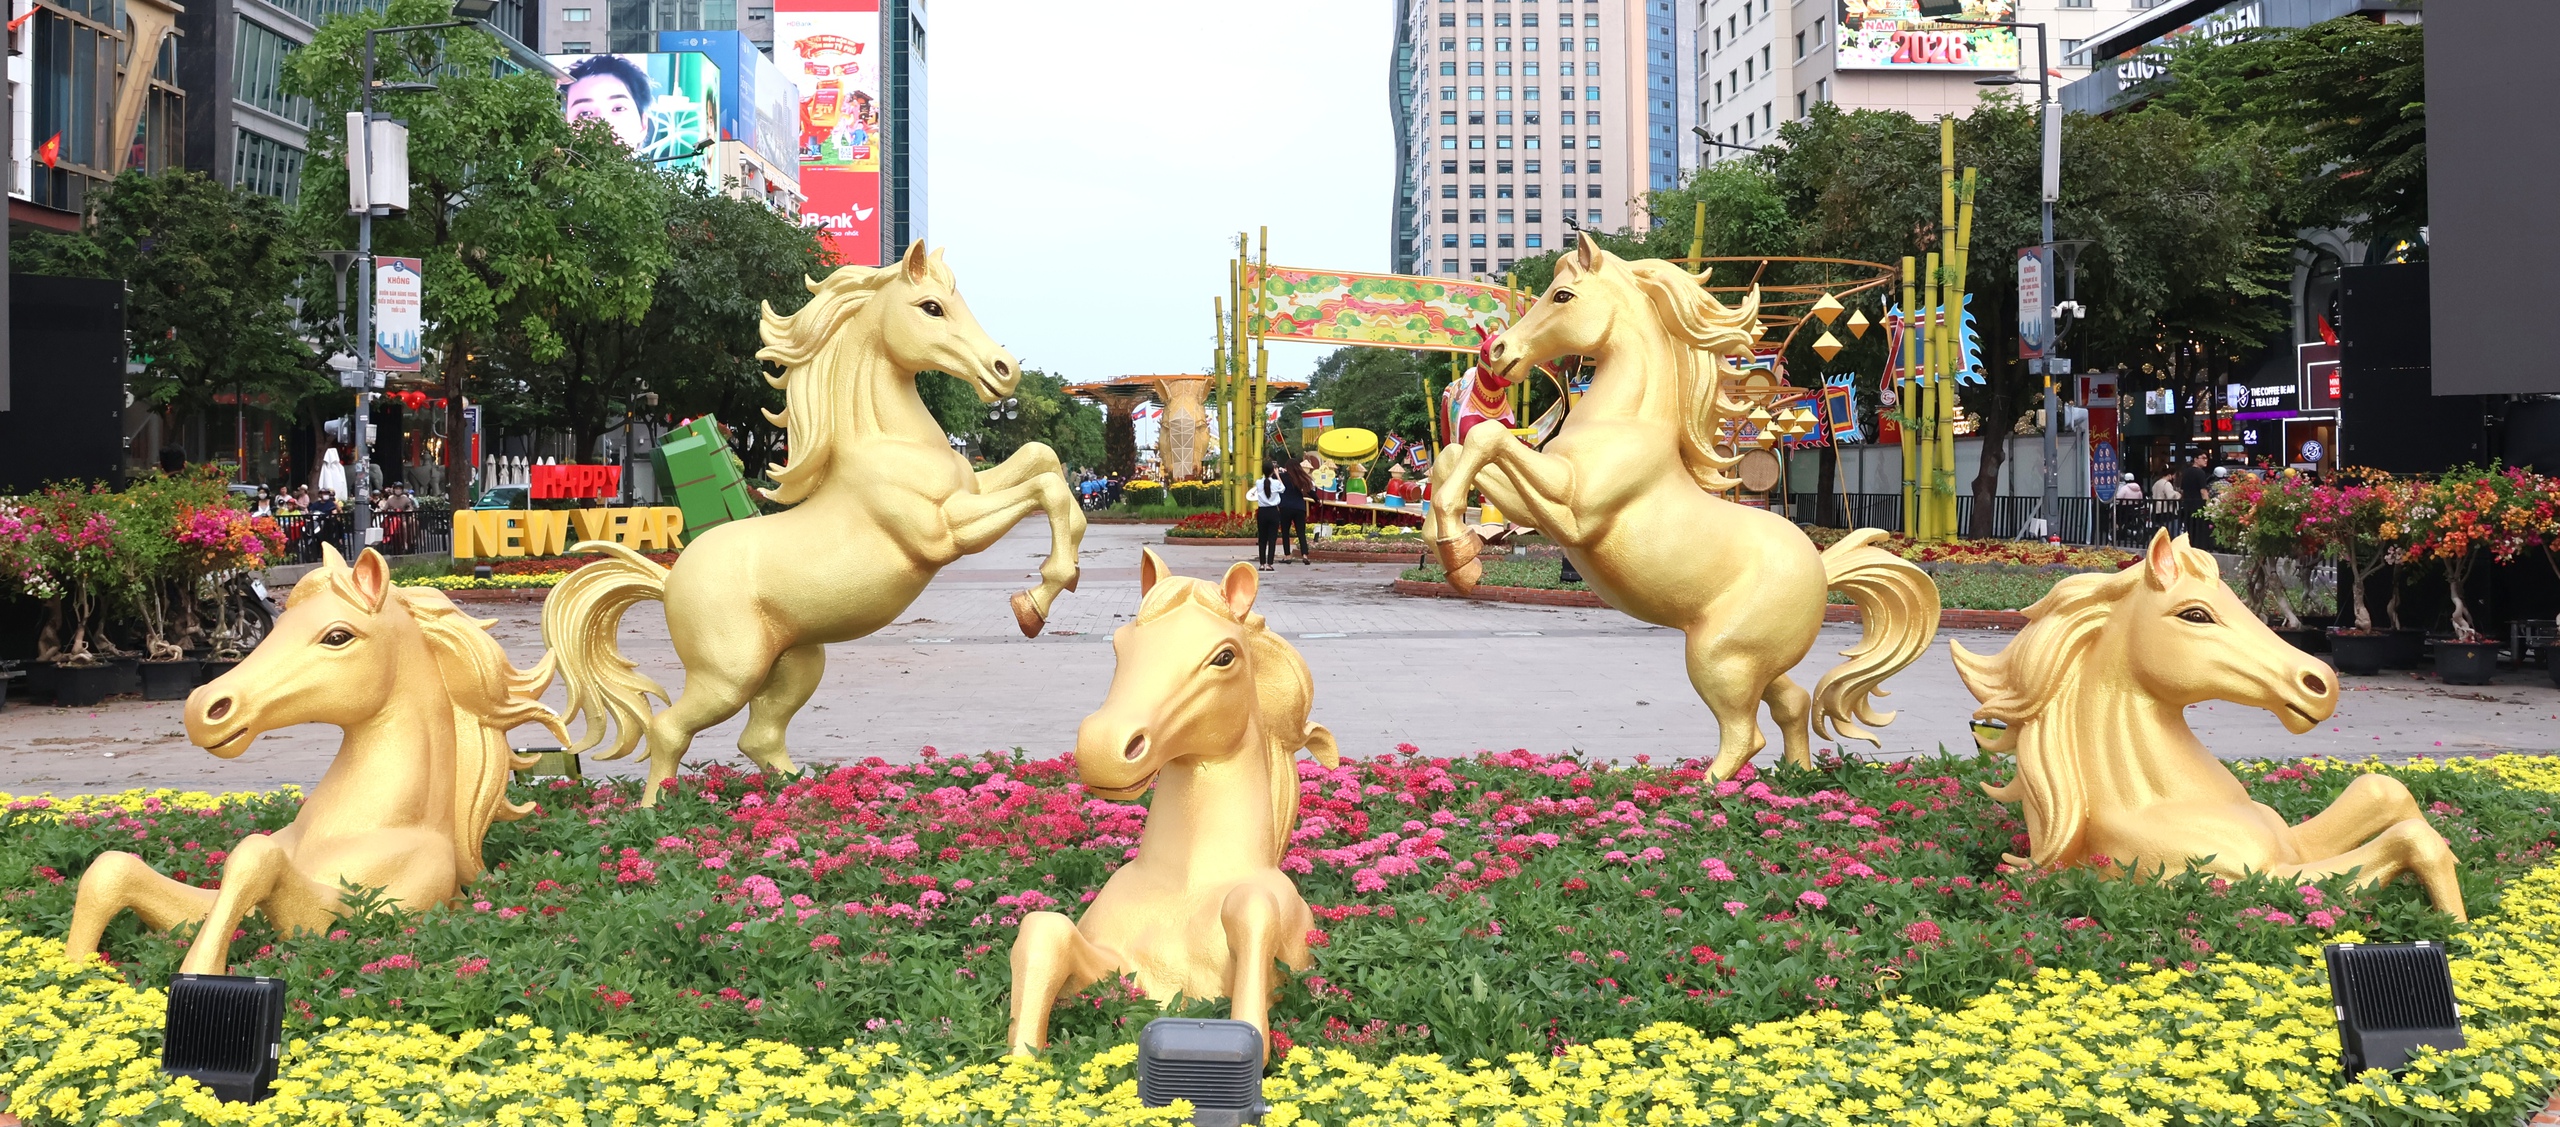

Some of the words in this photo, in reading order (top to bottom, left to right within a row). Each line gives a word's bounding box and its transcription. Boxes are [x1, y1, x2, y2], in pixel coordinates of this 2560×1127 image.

[2187, 2, 2261, 47] ARDEN
[1890, 30, 1968, 64] 2026
[387, 276, 410, 285] KHÔNG
[2250, 387, 2261, 397] THE
[2260, 385, 2280, 396] COFFEE
[2280, 384, 2296, 395] BEAN
[2255, 397, 2266, 407] TEA
[2266, 396, 2280, 406] LEAF
[2243, 430, 2257, 440] 24
[536, 465, 622, 498] HAPPY
[455, 509, 570, 558] NEW
[572, 506, 685, 551] YEAR
